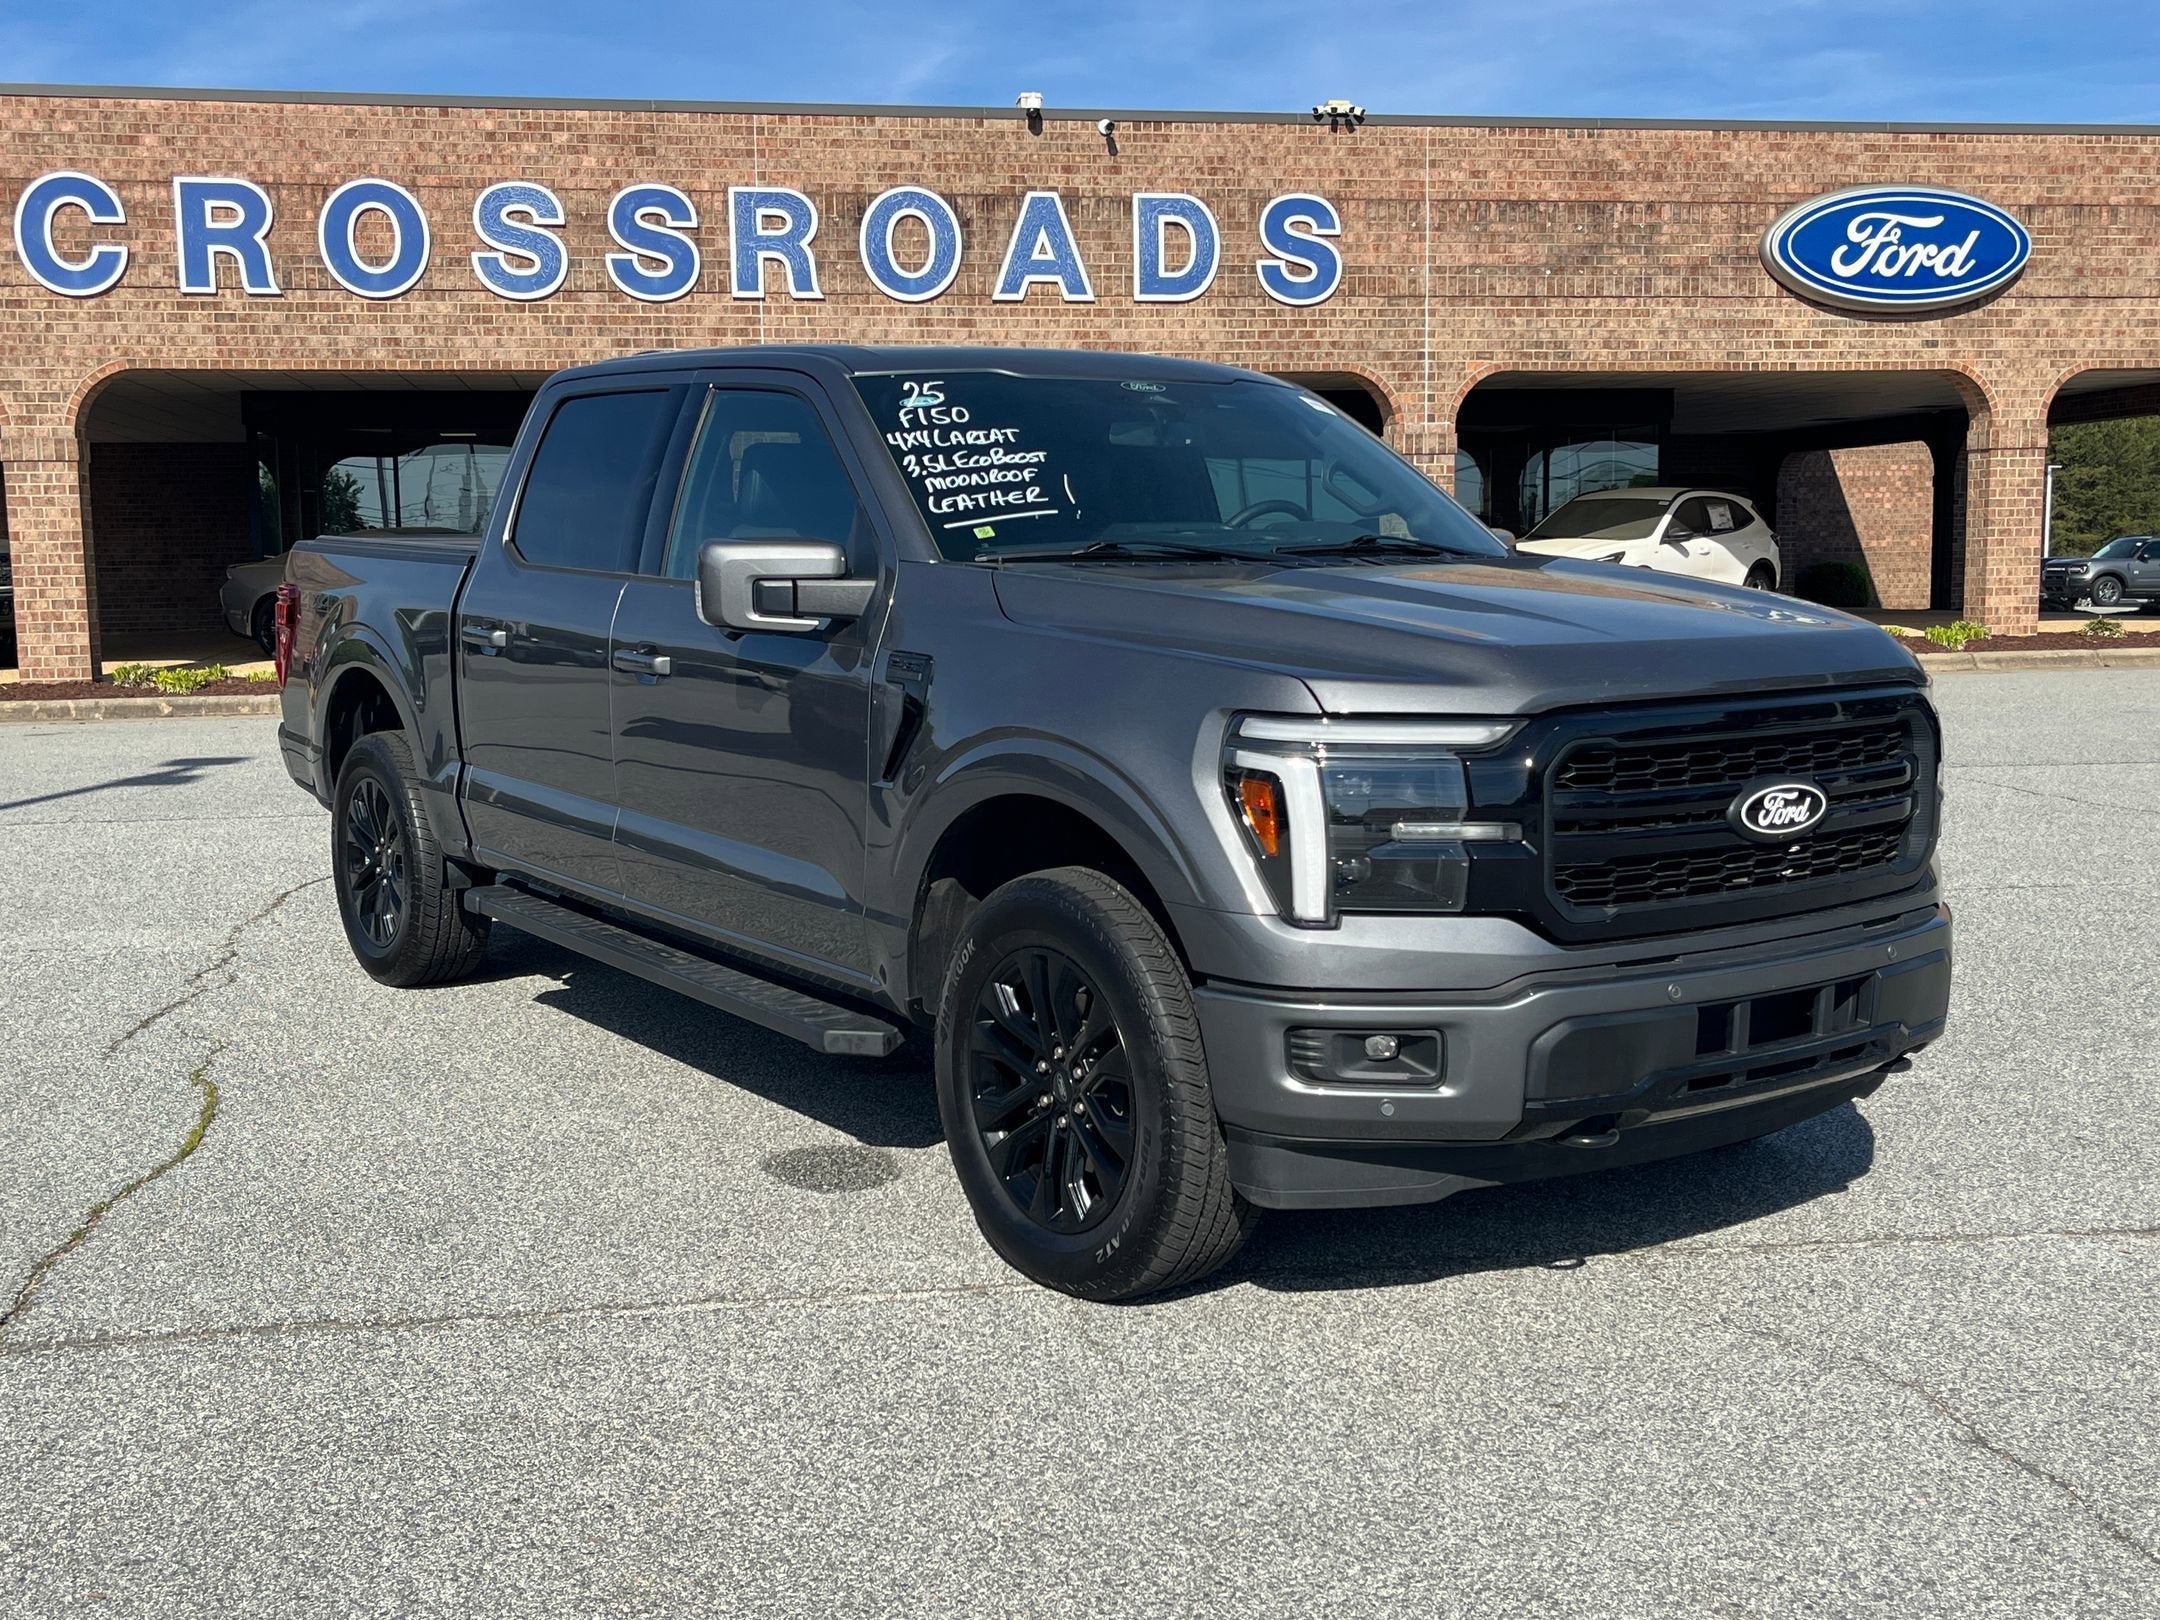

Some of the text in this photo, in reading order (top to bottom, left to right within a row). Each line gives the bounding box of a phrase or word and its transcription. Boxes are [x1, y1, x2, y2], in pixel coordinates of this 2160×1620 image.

[13, 169, 1344, 306] CROSSROADS
[1830, 211, 1981, 278] Ford
[902, 381, 945, 408] 25
[899, 406, 969, 428] F150
[924, 468, 1038, 493] MOONROOF
[928, 486, 1049, 514] LEATHER
[1757, 791, 1812, 827] Ford
